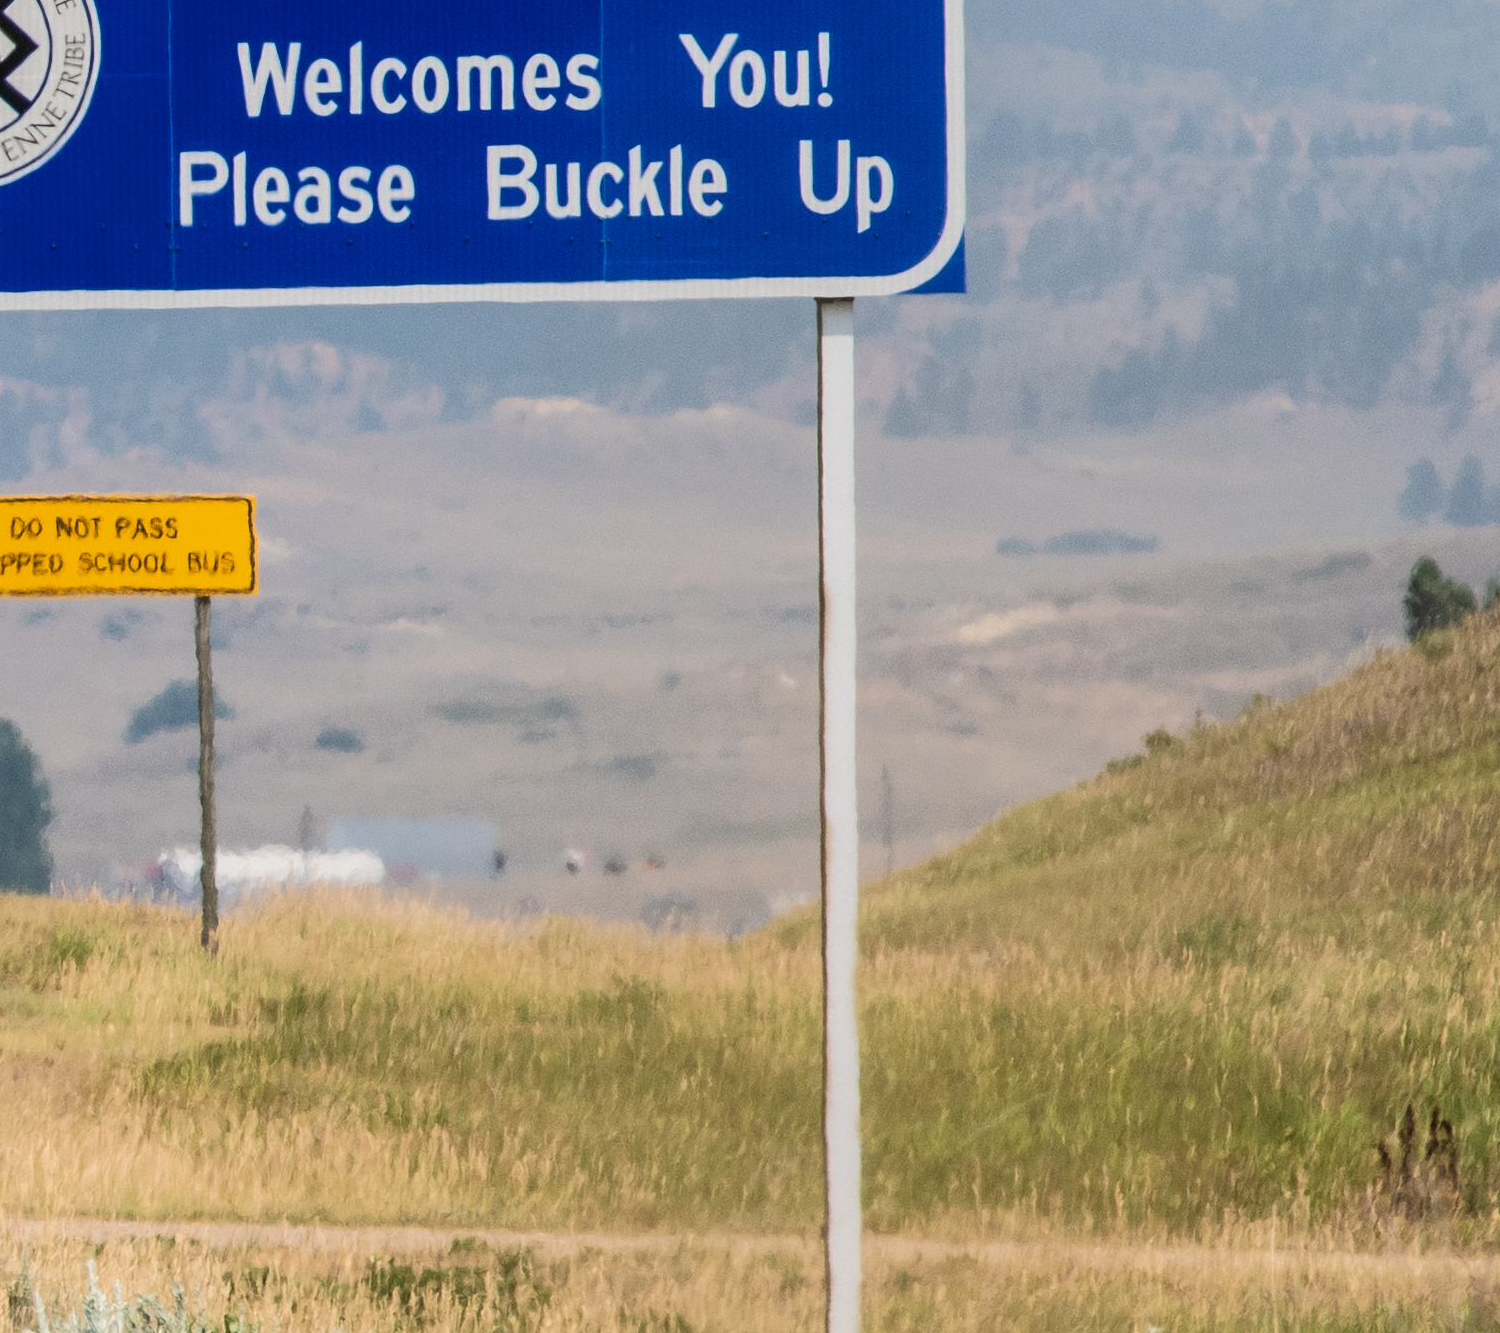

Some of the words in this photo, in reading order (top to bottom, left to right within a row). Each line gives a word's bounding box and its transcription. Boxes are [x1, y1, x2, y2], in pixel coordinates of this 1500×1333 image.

[52, 33, 86, 99] TRIBE
[236, 40, 603, 118] Welcomes
[678, 31, 834, 109] You!
[178, 150, 416, 227] Please
[486, 144, 728, 221] Buckle
[798, 139, 895, 234] Up
[10, 517, 43, 540] DO
[55, 516, 101, 539] NOT
[114, 517, 178, 540] PASS
[78, 552, 172, 574] SCHOOL
[187, 552, 235, 573] BUS
